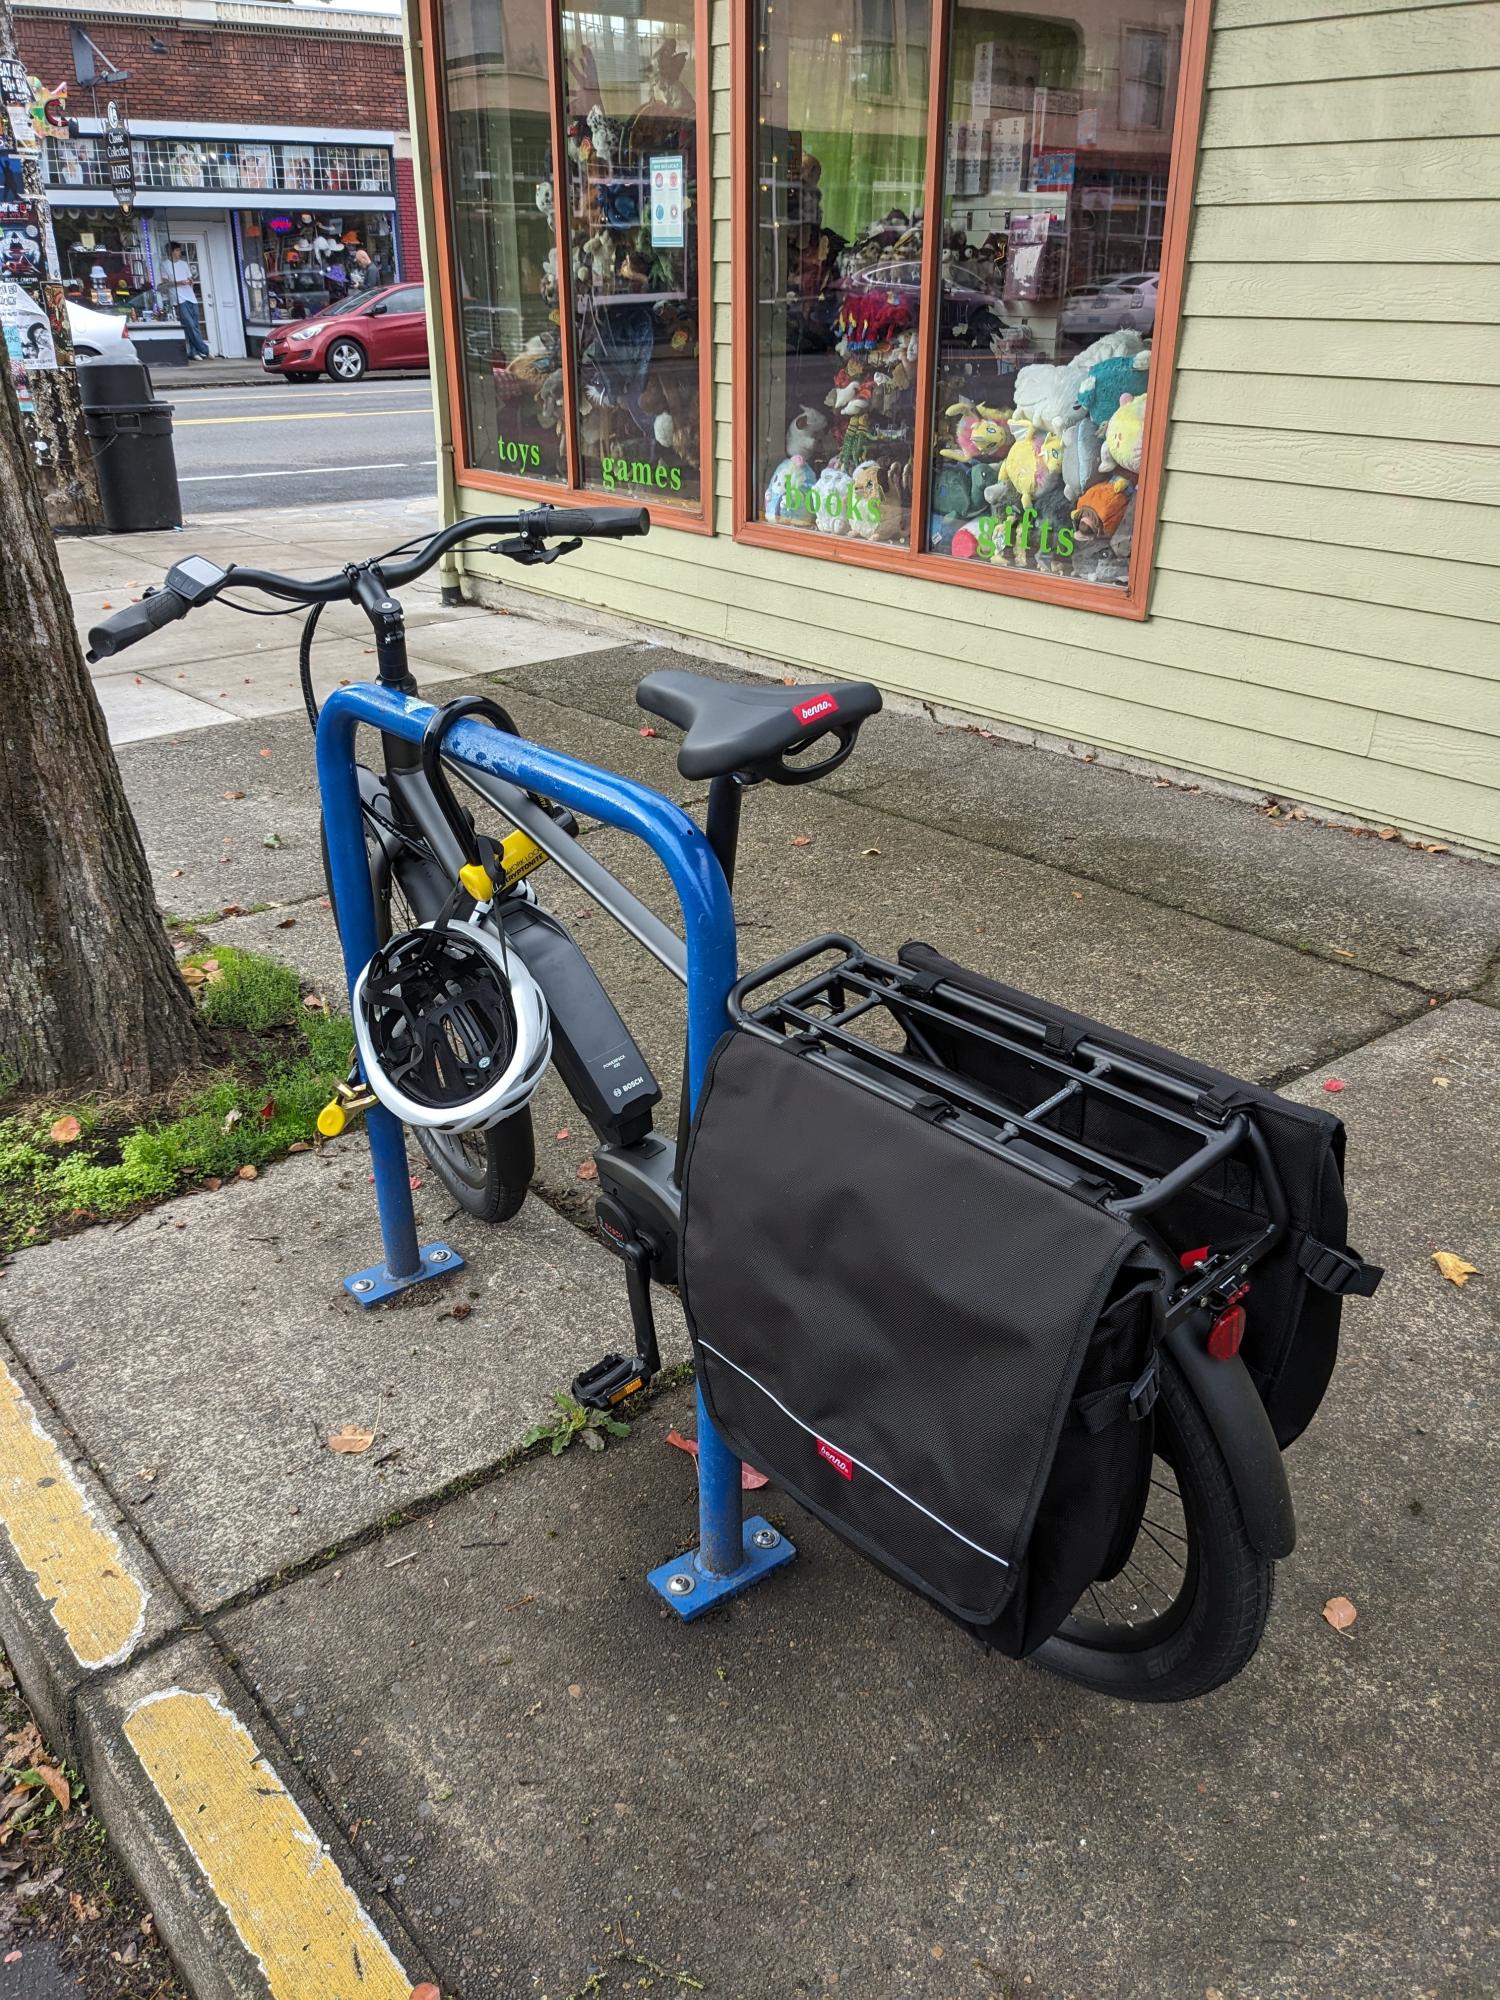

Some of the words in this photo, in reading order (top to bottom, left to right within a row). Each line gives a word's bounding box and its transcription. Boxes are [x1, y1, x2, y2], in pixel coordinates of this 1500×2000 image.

[107, 146, 129, 158] Collection
[111, 165, 131, 180] HATS
[498, 435, 540, 474] toys
[602, 456, 682, 492] games
[784, 474, 881, 523] books
[976, 504, 1075, 559] gifts
[622, 1076, 644, 1092] BOSCH
